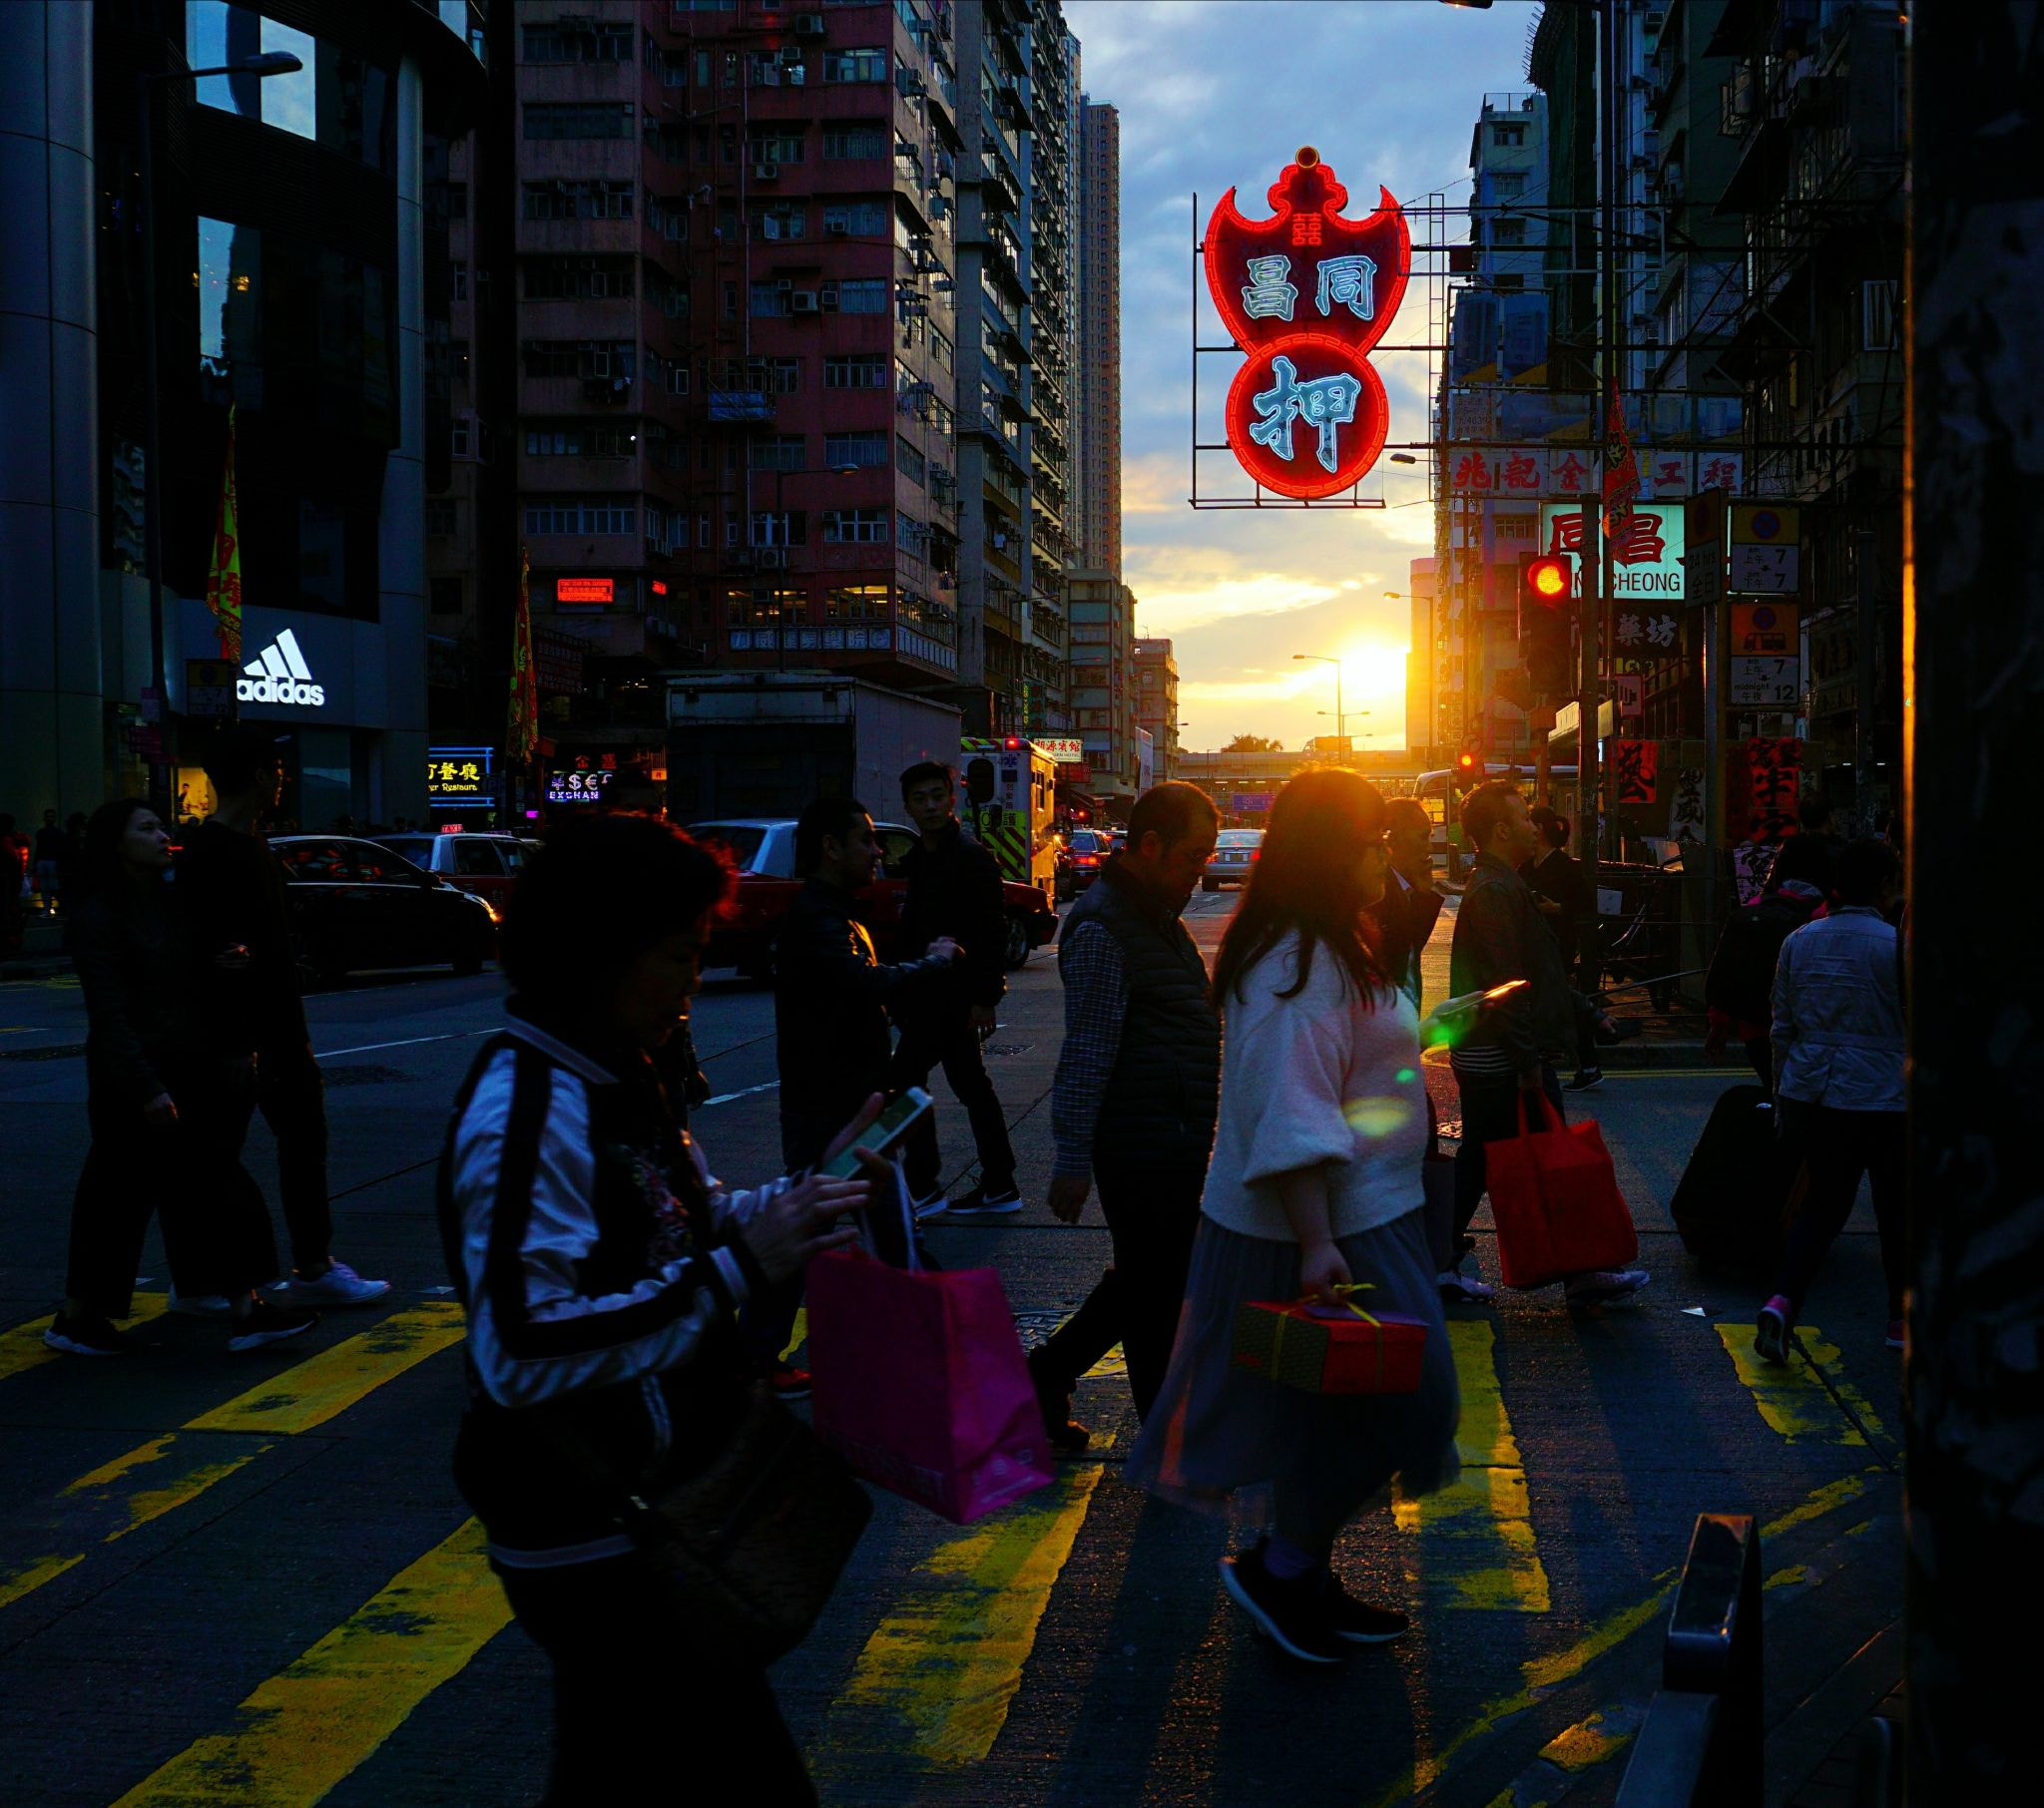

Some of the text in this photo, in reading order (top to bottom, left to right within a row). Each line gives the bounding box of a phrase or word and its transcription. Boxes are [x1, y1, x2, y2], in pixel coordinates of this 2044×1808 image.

[1250, 355, 1361, 474] 押
[1689, 553, 1701, 570] 24
[1776, 550, 1787, 564] 7
[1613, 573, 1681, 592] CHEONG
[1693, 573, 1716, 601] 全日
[1776, 574, 1787, 588] 7
[1775, 660, 1786, 675] 7
[237, 676, 325, 706] adidas
[1742, 691, 1763, 702] 午夜
[1775, 685, 1794, 701] 12
